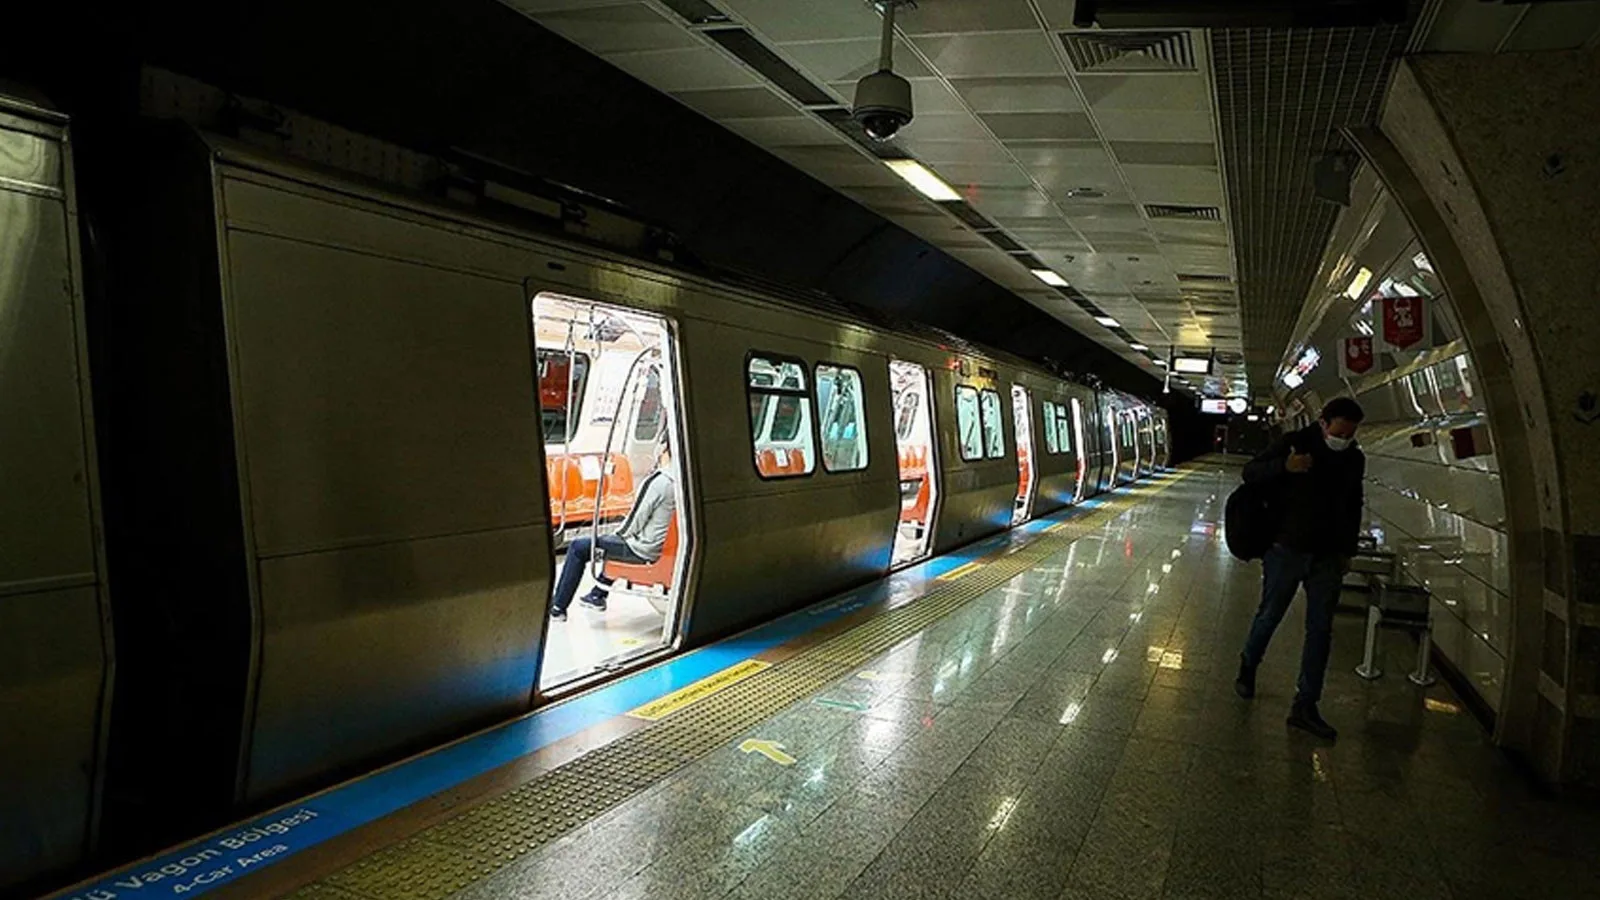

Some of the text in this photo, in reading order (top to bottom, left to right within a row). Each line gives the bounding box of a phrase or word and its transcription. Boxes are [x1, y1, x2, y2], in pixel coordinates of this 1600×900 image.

[114, 848, 223, 889] Vagon
[220, 808, 319, 849] Bölgesi
[173, 844, 288, 894] 4-Car Area
